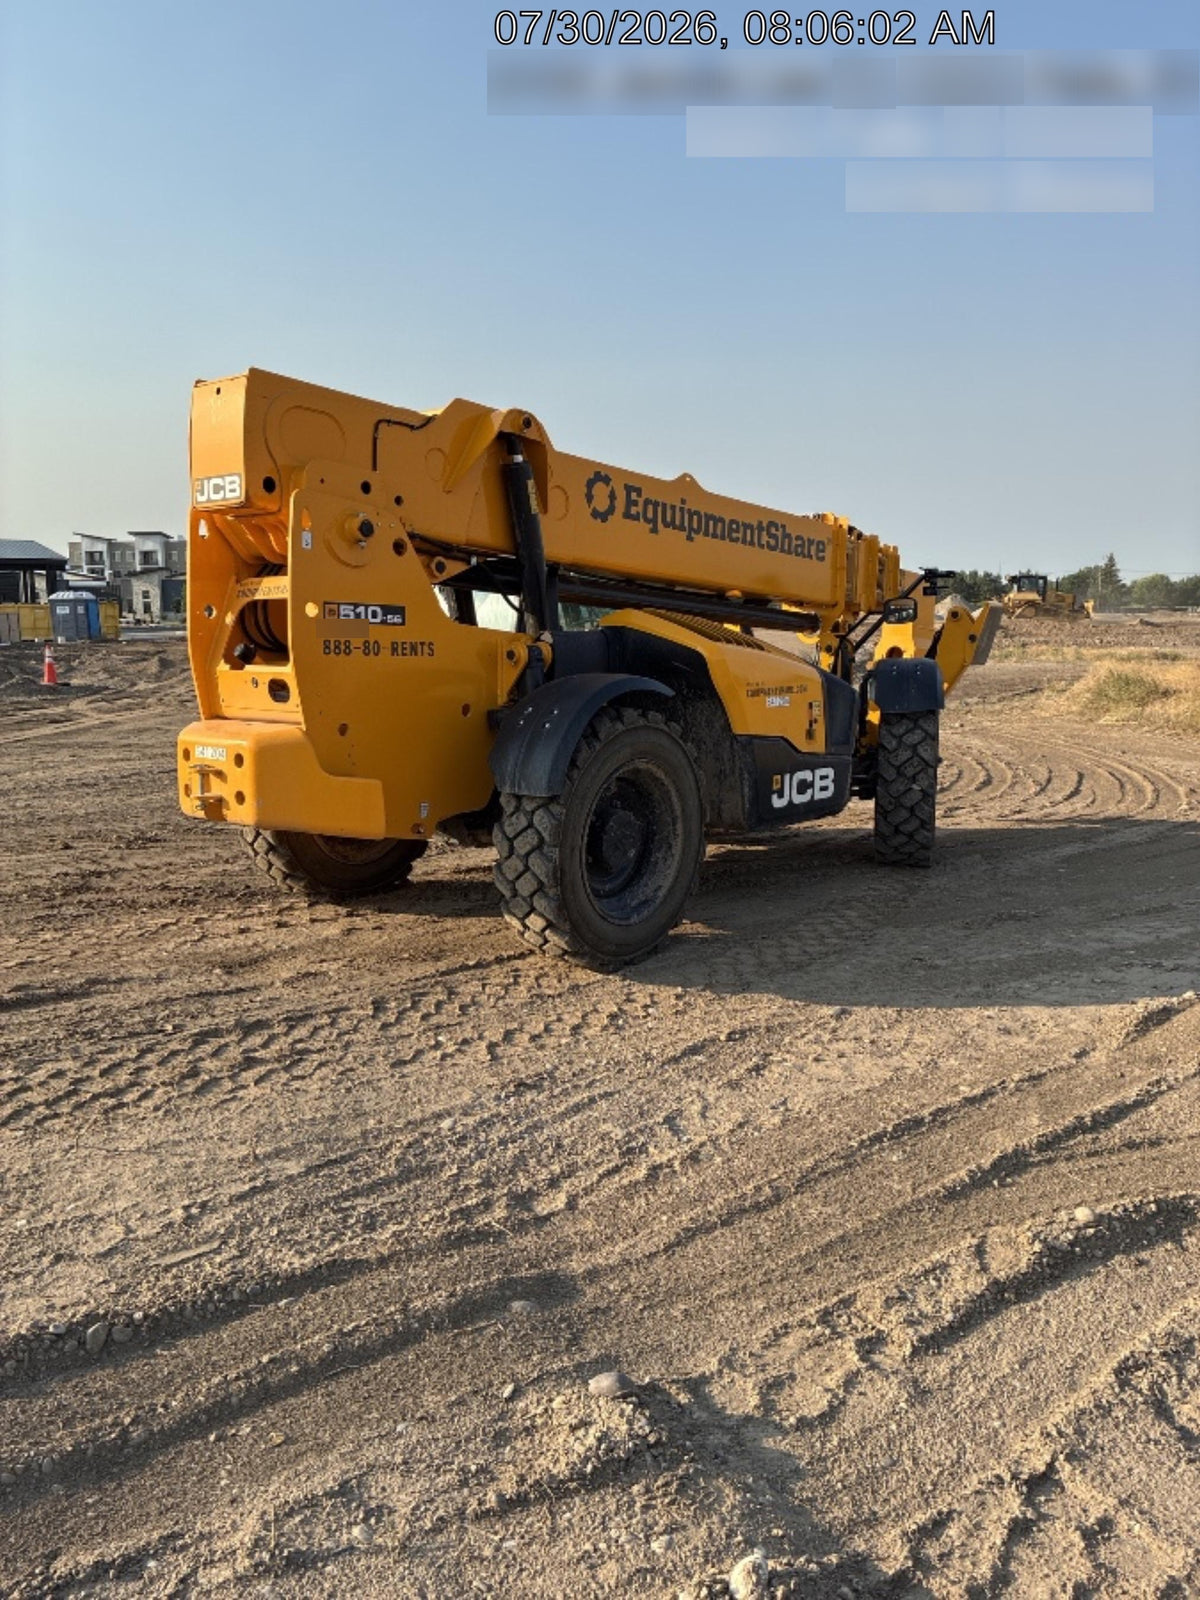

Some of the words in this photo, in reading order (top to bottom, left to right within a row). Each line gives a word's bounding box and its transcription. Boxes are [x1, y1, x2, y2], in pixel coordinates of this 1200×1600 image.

[196, 476, 241, 502] JCB
[622, 483, 825, 561] EquipmentShare
[771, 767, 834, 808] JCB
